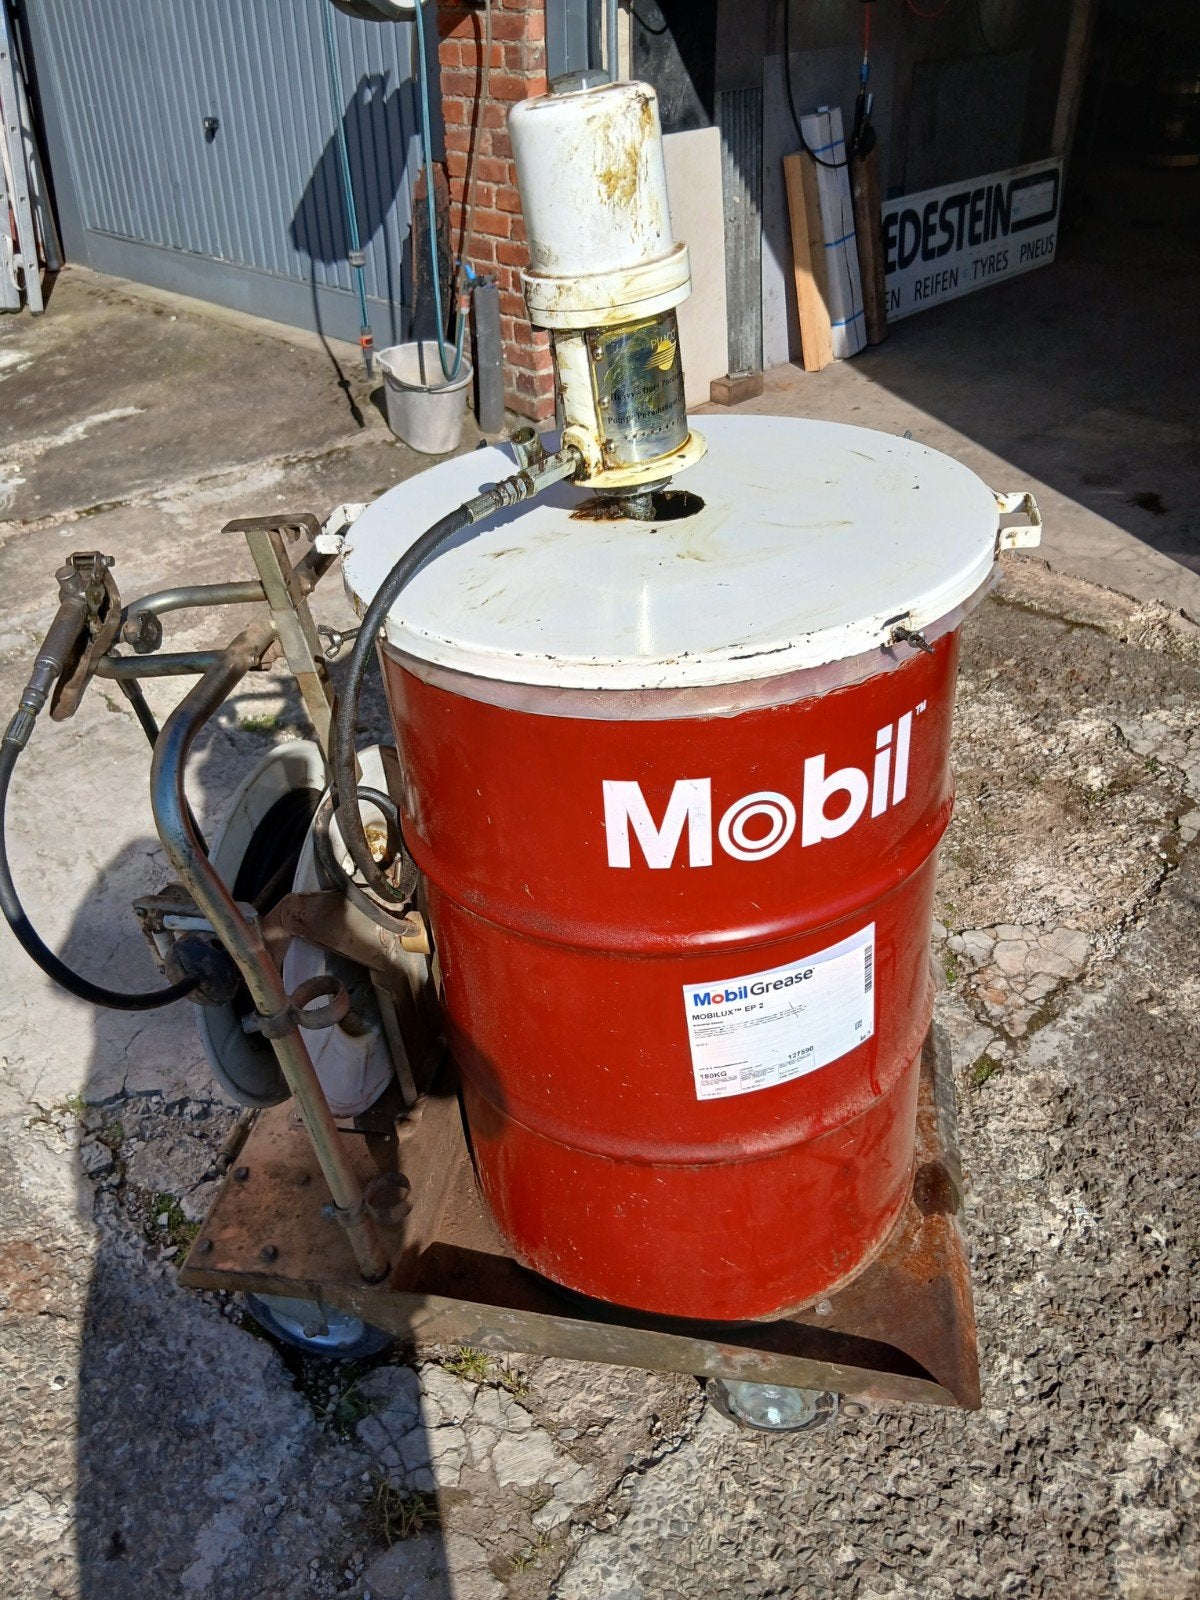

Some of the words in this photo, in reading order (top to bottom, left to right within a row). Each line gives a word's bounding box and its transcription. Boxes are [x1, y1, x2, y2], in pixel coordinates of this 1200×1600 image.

[882, 183, 1012, 276] EDESTEIN
[914, 267, 959, 301] REIFEN
[972, 250, 1009, 280] TYRES
[1019, 234, 1055, 263] PNEUS
[744, 1005, 757, 1013] EP
